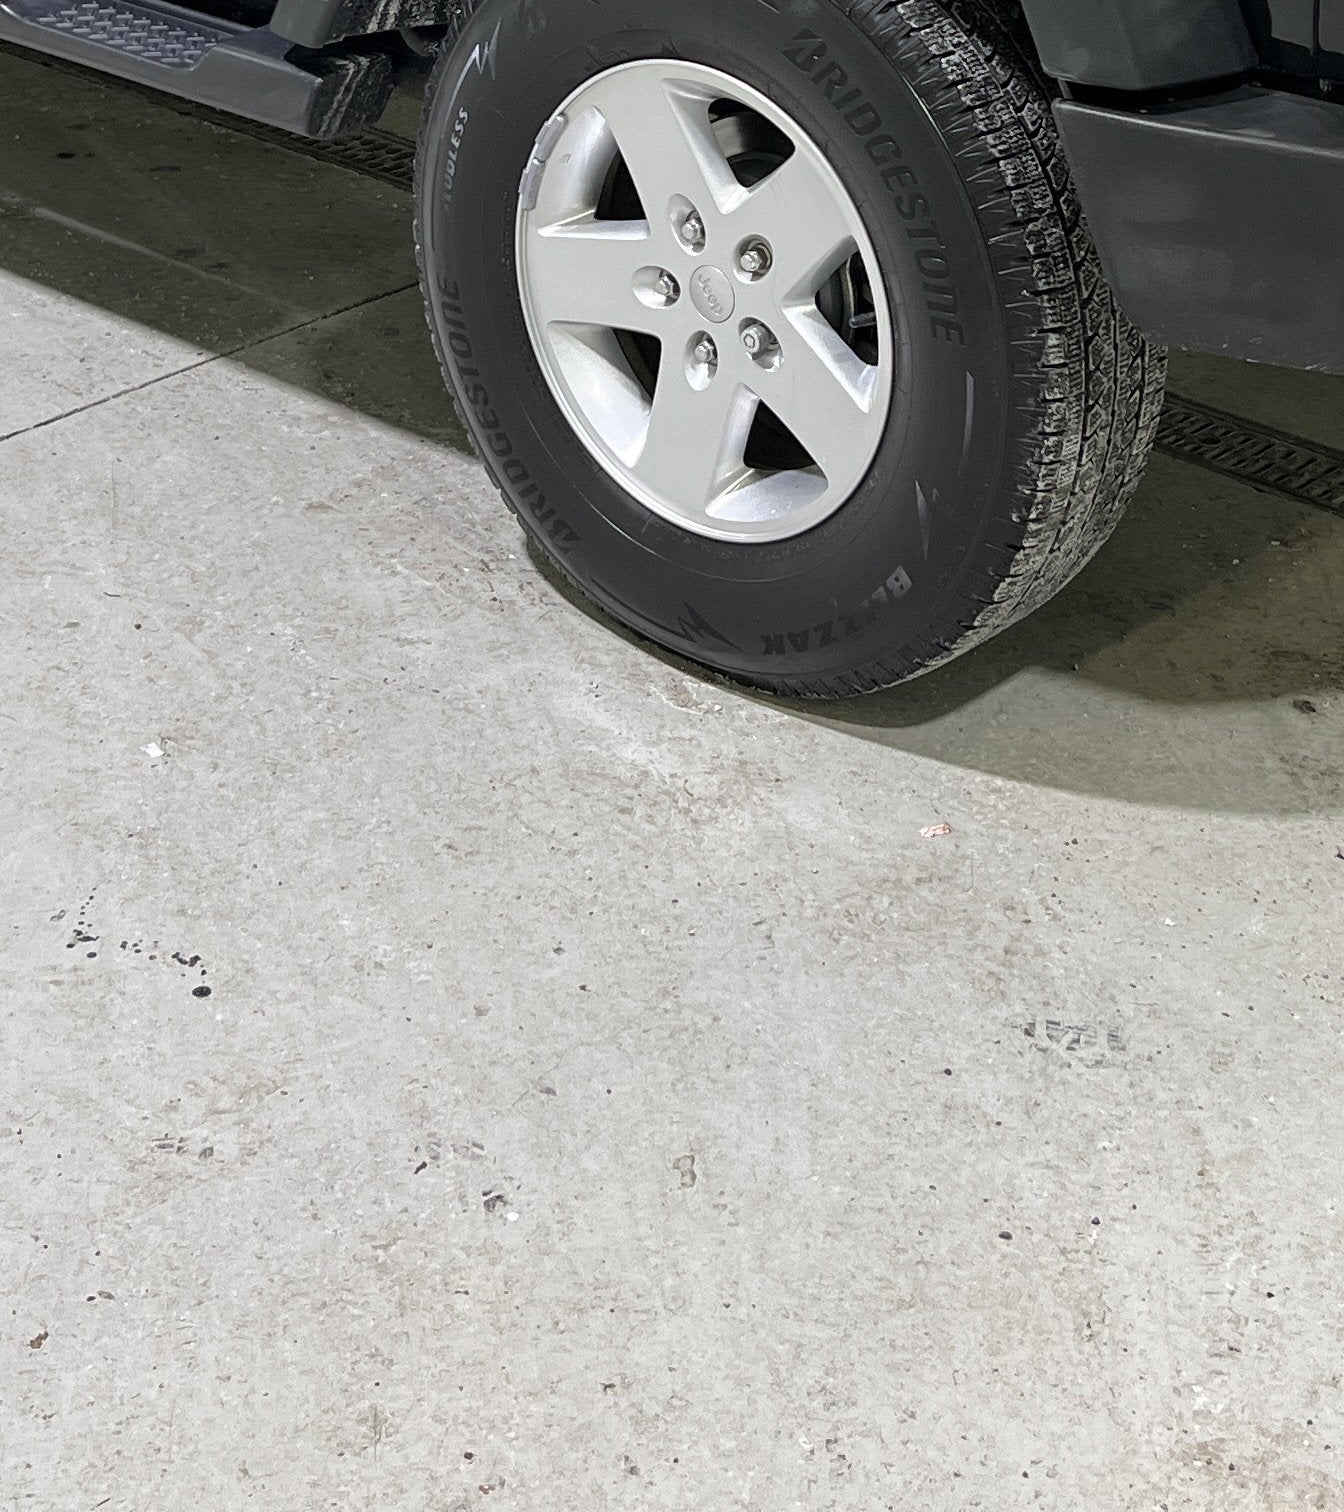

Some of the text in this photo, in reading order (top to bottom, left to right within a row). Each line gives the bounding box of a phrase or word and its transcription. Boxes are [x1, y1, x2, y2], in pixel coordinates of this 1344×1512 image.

[697, 273, 723, 315] Jeep
[780, 28, 968, 348] BRIDGESTONE
[436, 273, 581, 556] BRIDGESTONE
